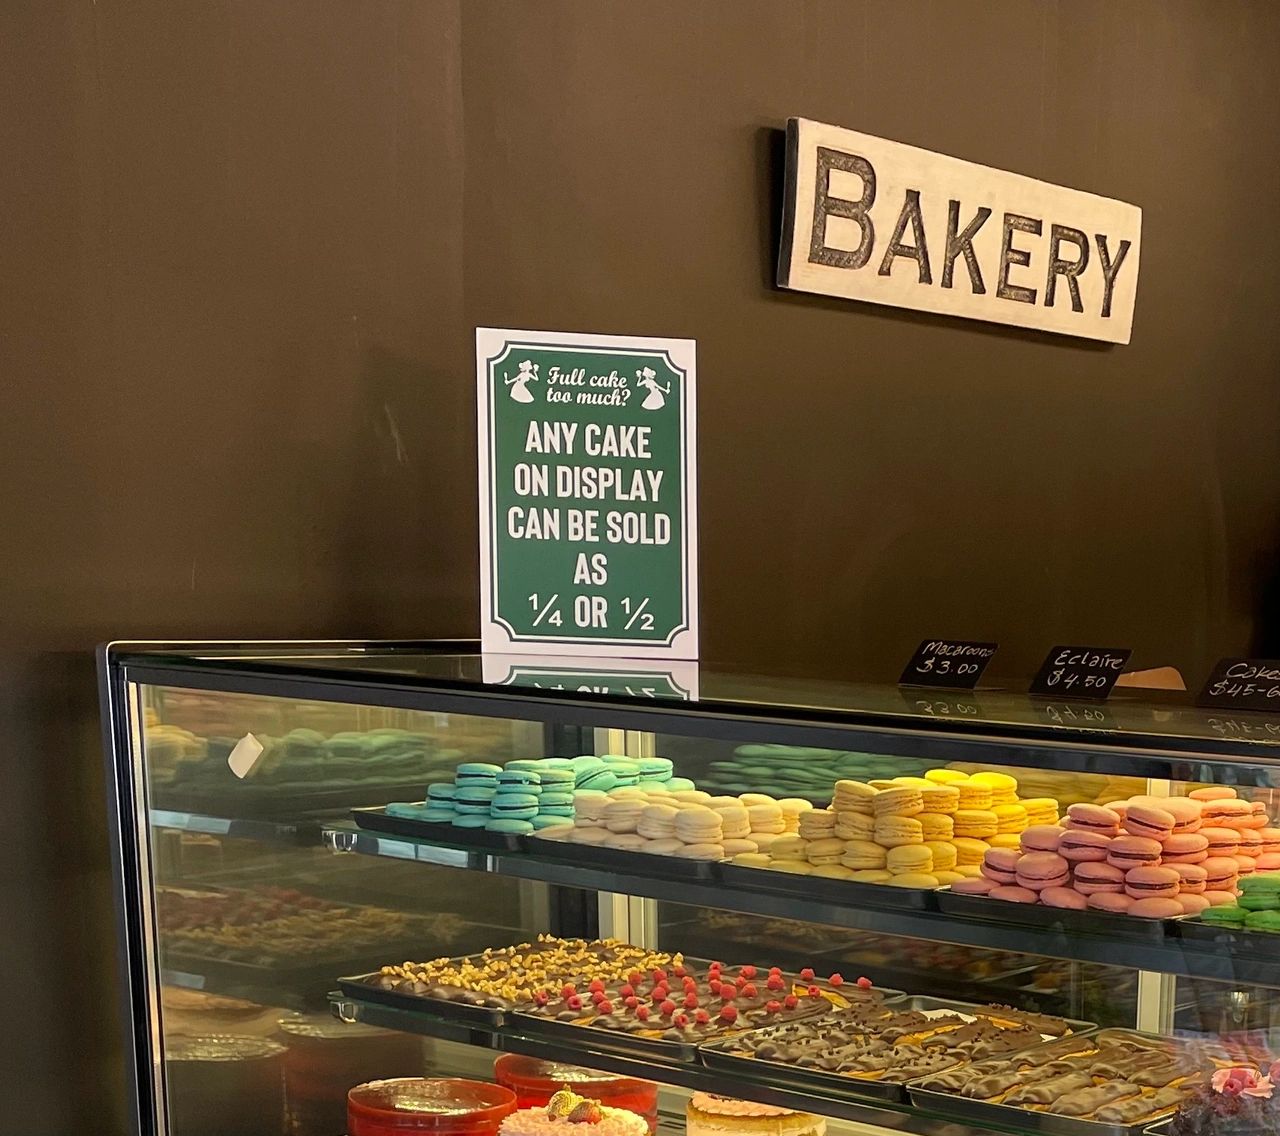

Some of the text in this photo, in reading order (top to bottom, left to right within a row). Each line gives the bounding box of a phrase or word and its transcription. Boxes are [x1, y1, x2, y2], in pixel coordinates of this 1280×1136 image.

[808, 146, 1131, 317] BAKERY
[547, 366, 628, 389] Full cake
[546, 388, 631, 407] too much?
[525, 420, 651, 459] ANY CAKE
[514, 463, 664, 502] ON DISPLAY
[507, 506, 670, 545] CAN BE SOLD
[573, 552, 608, 585] AS
[574, 595, 608, 628] OR
[1047, 668, 1106, 689] $4.50
